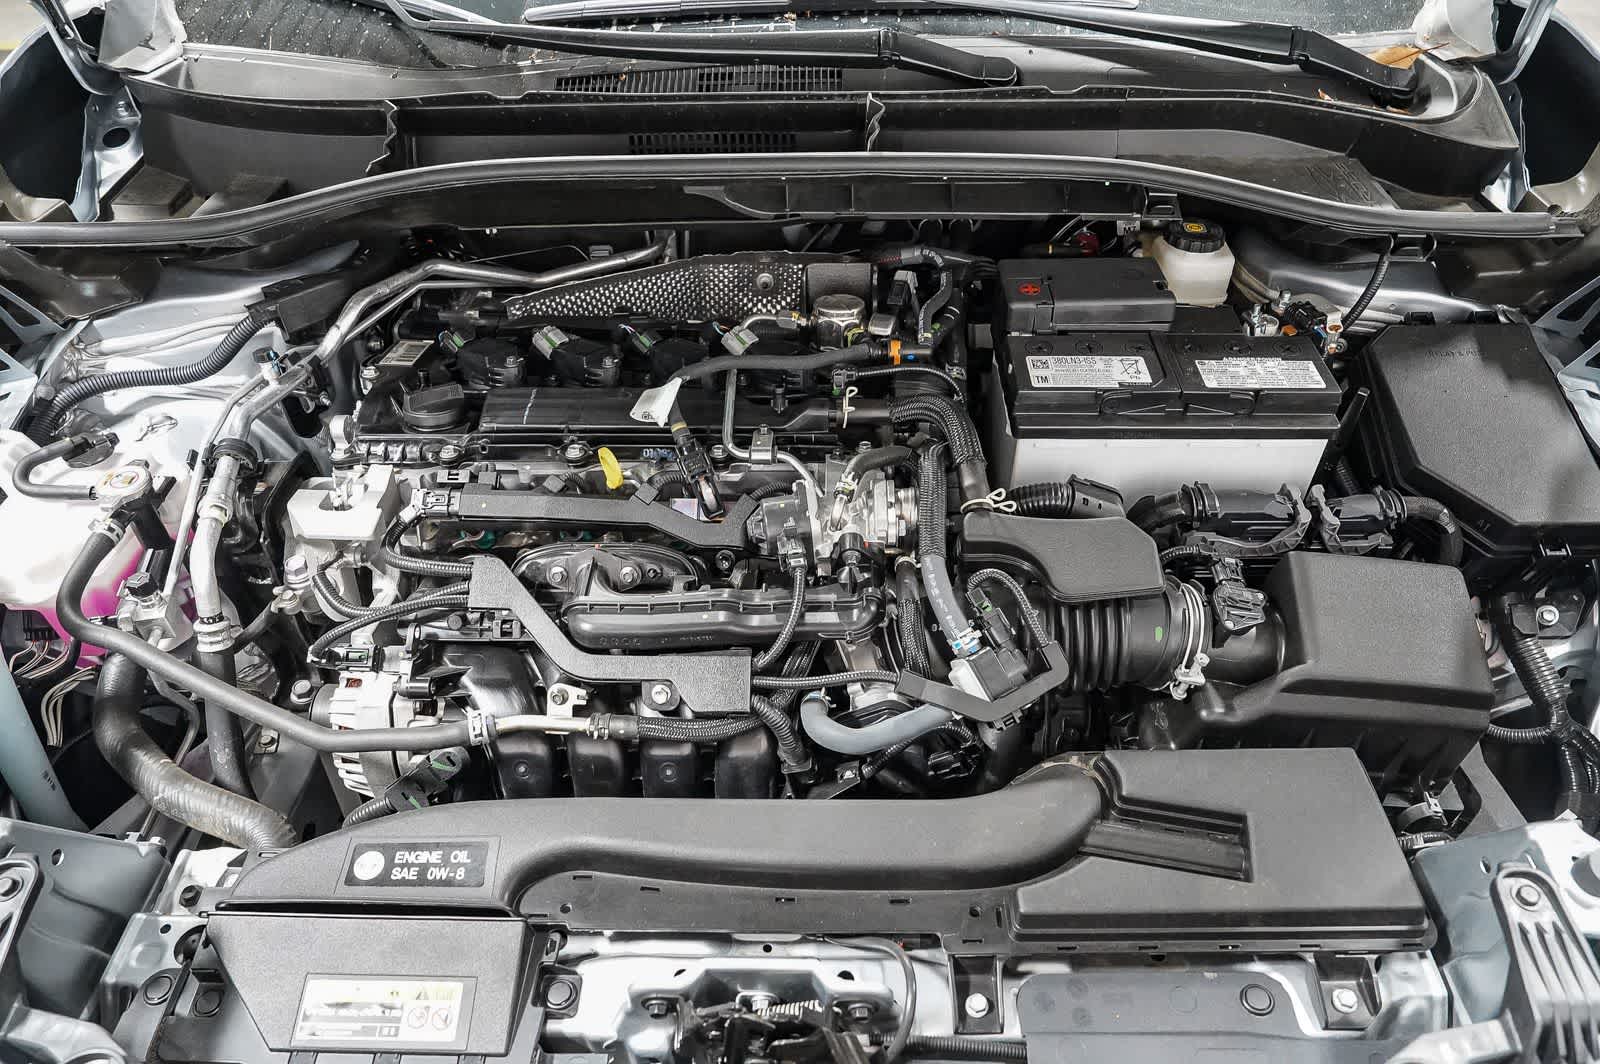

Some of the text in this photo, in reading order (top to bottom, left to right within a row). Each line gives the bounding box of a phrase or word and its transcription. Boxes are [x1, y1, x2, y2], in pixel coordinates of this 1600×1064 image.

[1035, 375, 1049, 384] TM
[394, 850, 471, 864] ENGINE OIL
[390, 866, 466, 880] SAE 0W-8
